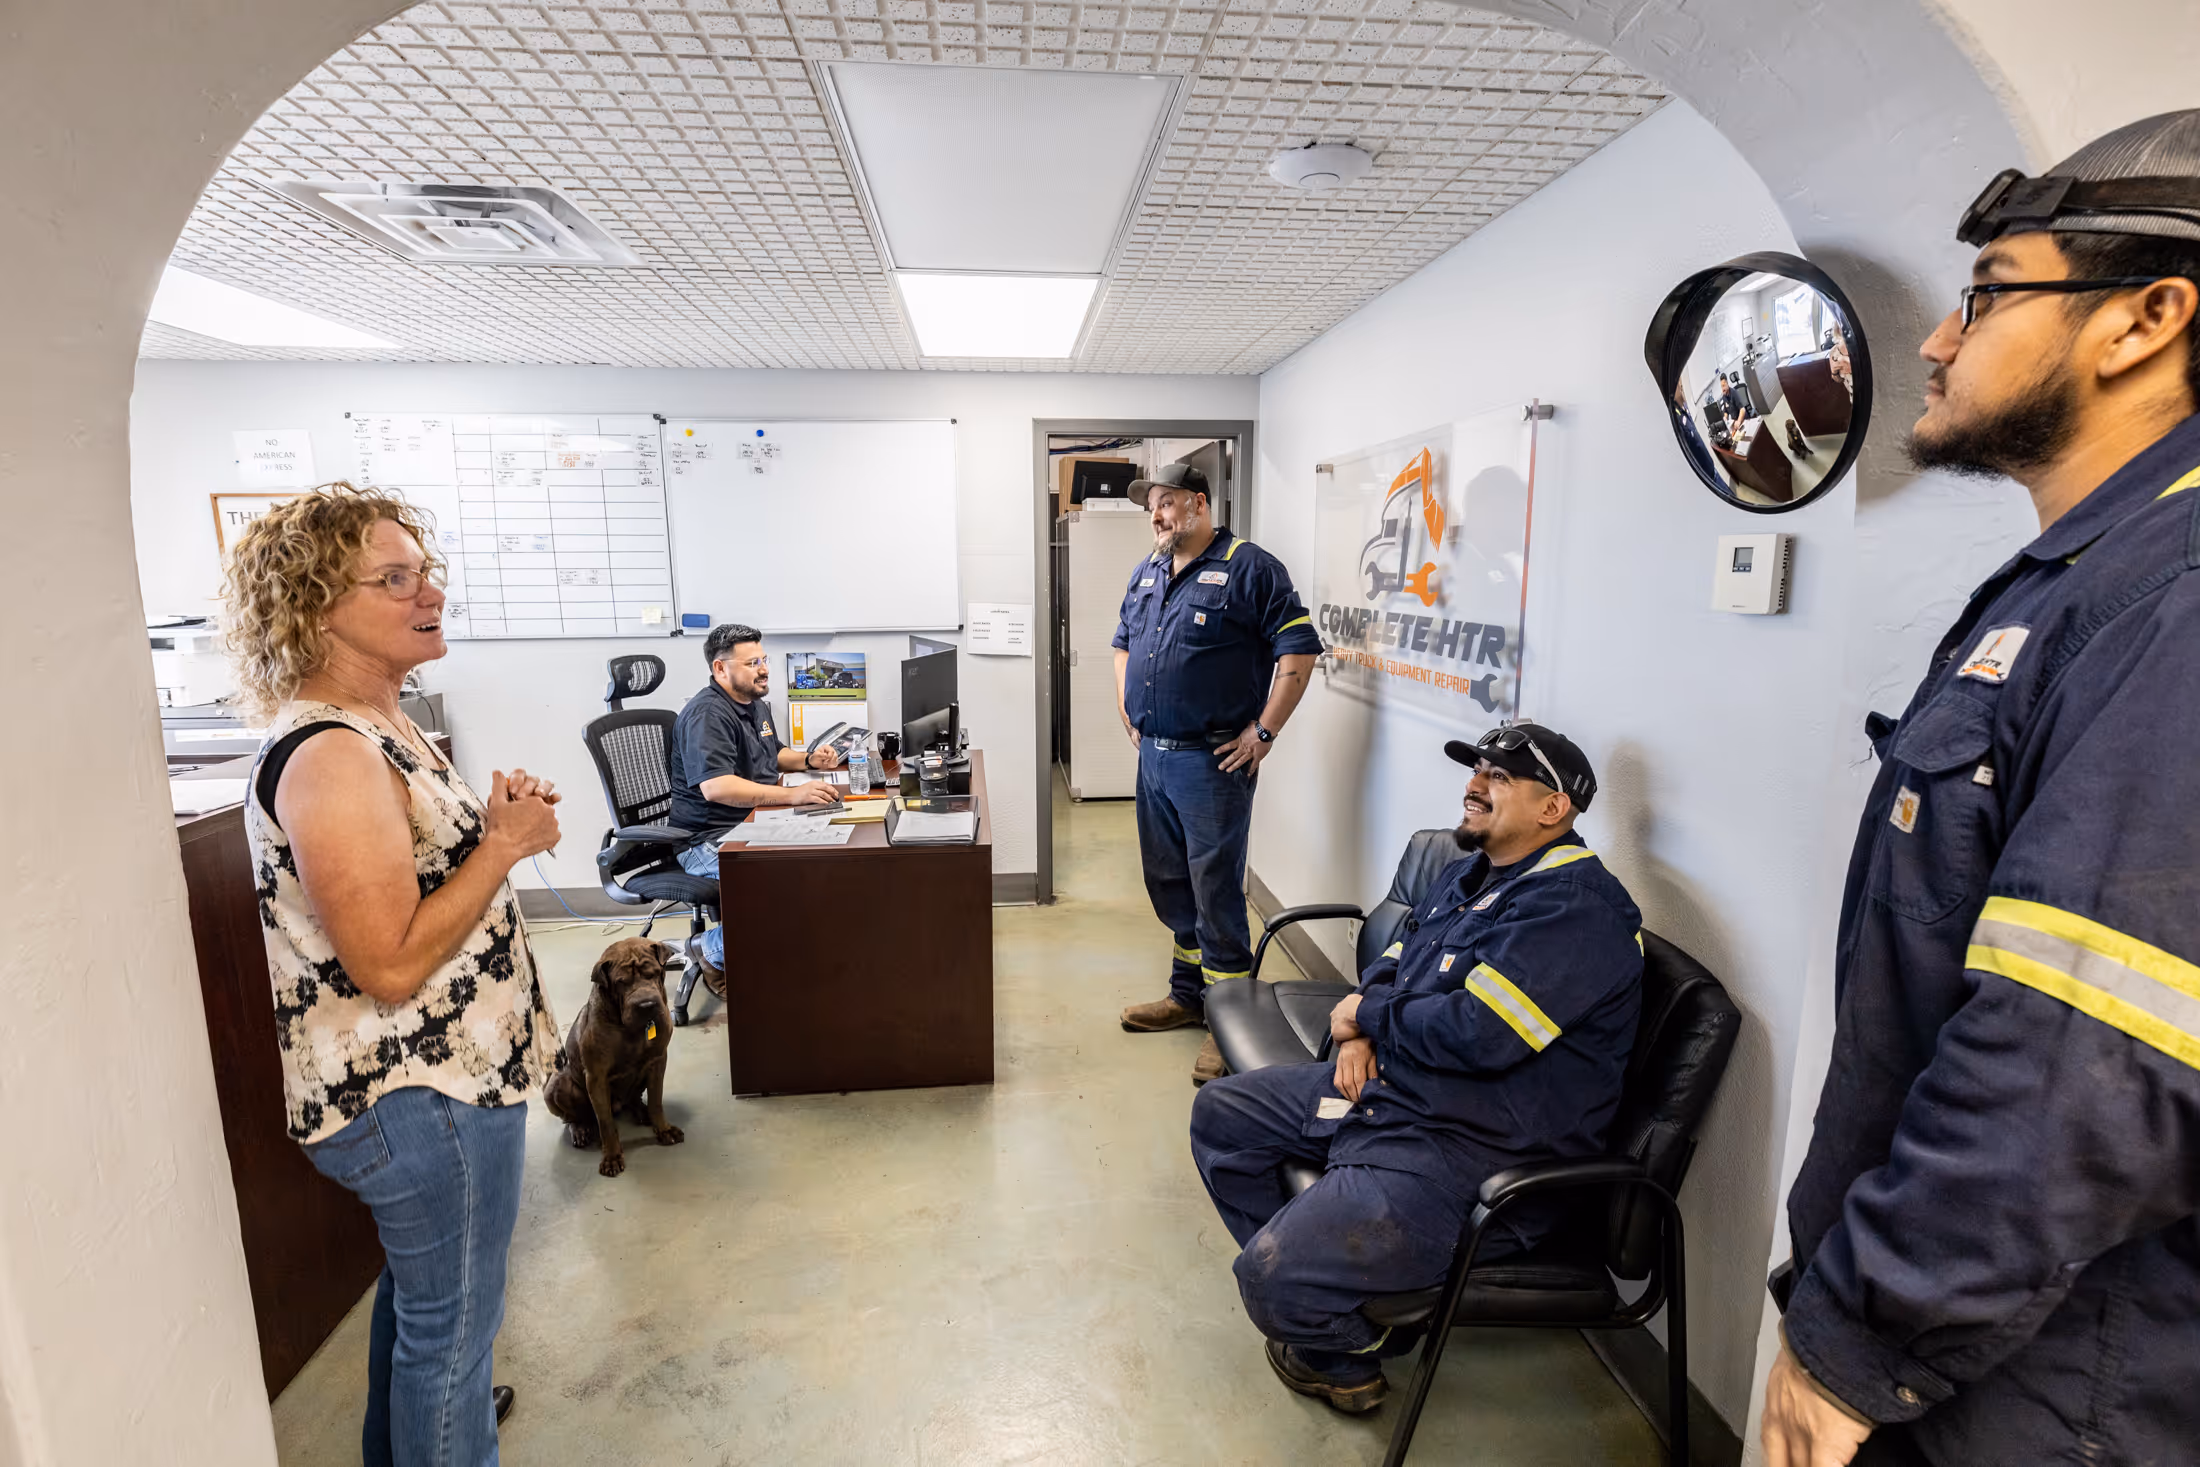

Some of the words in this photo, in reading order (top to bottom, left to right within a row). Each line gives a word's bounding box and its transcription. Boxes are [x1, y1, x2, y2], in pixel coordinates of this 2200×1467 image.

[254, 452, 296, 460] AMERICAN
[1319, 603, 1434, 653] COMPLETE
[1436, 618, 1506, 669] HTR
[1333, 645, 1353, 663] HEAVY
[1355, 650, 1377, 669] TRUCK
[1378, 658, 1384, 671] &
[1386, 659, 1433, 685] EQUIPMENT
[1434, 671, 1470, 696] REPAIR
